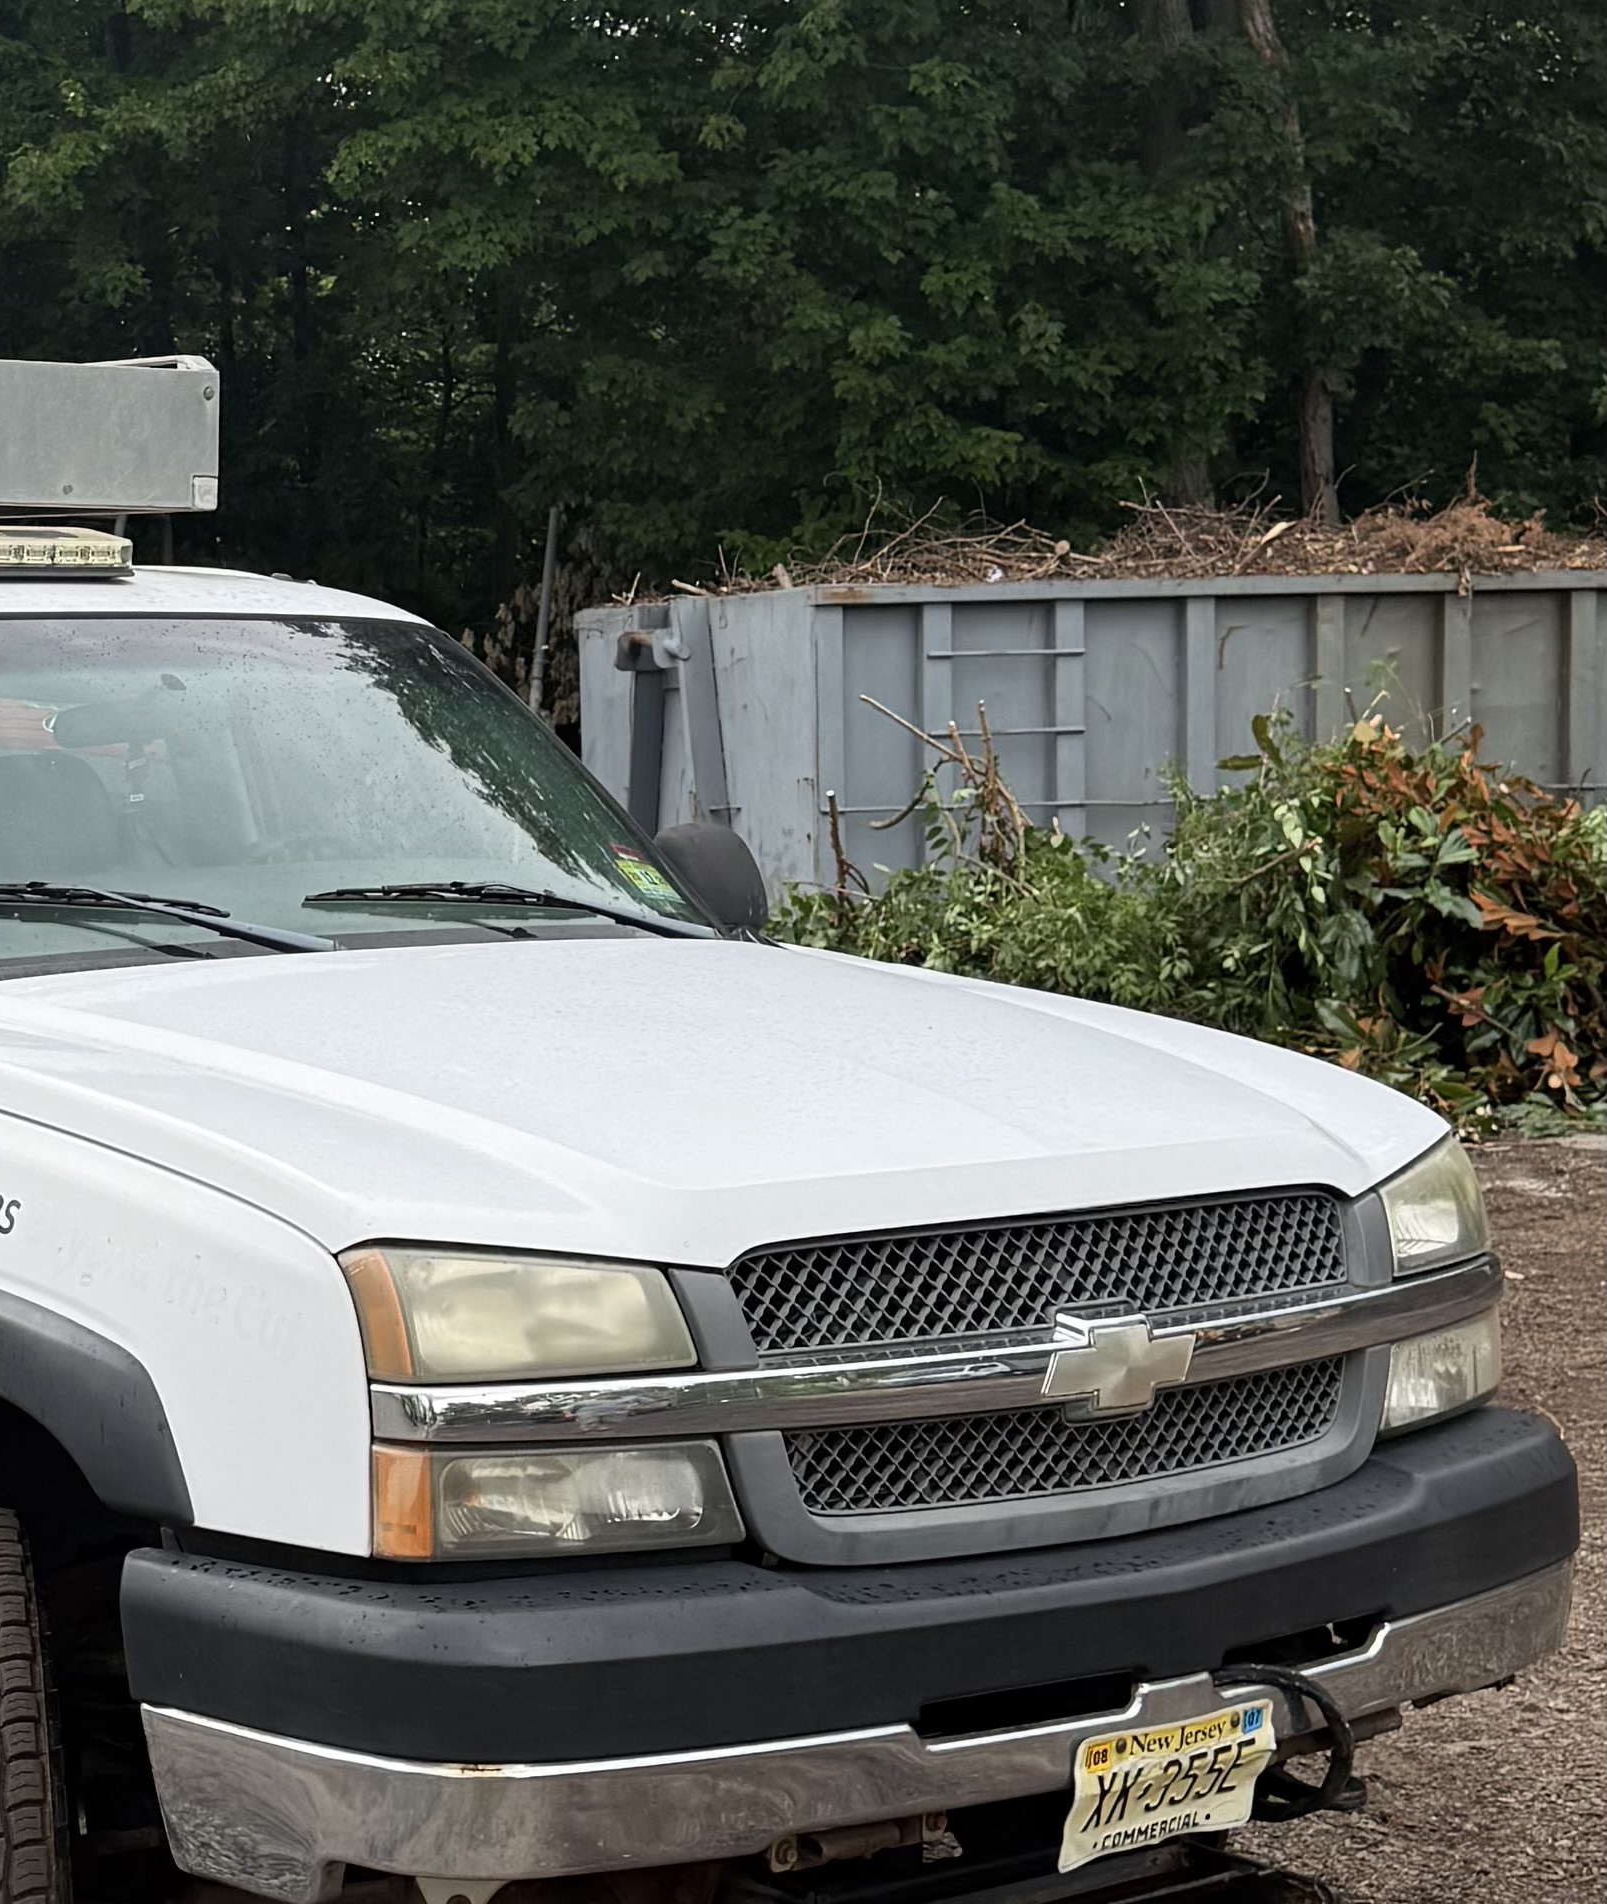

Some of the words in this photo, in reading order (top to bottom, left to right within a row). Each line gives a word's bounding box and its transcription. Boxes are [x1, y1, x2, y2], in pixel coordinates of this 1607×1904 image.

[1129, 1733, 1175, 1756] New
[1175, 1720, 1227, 1753] Jersey
[1101, 1810, 1199, 1850] COMMERCIAL
